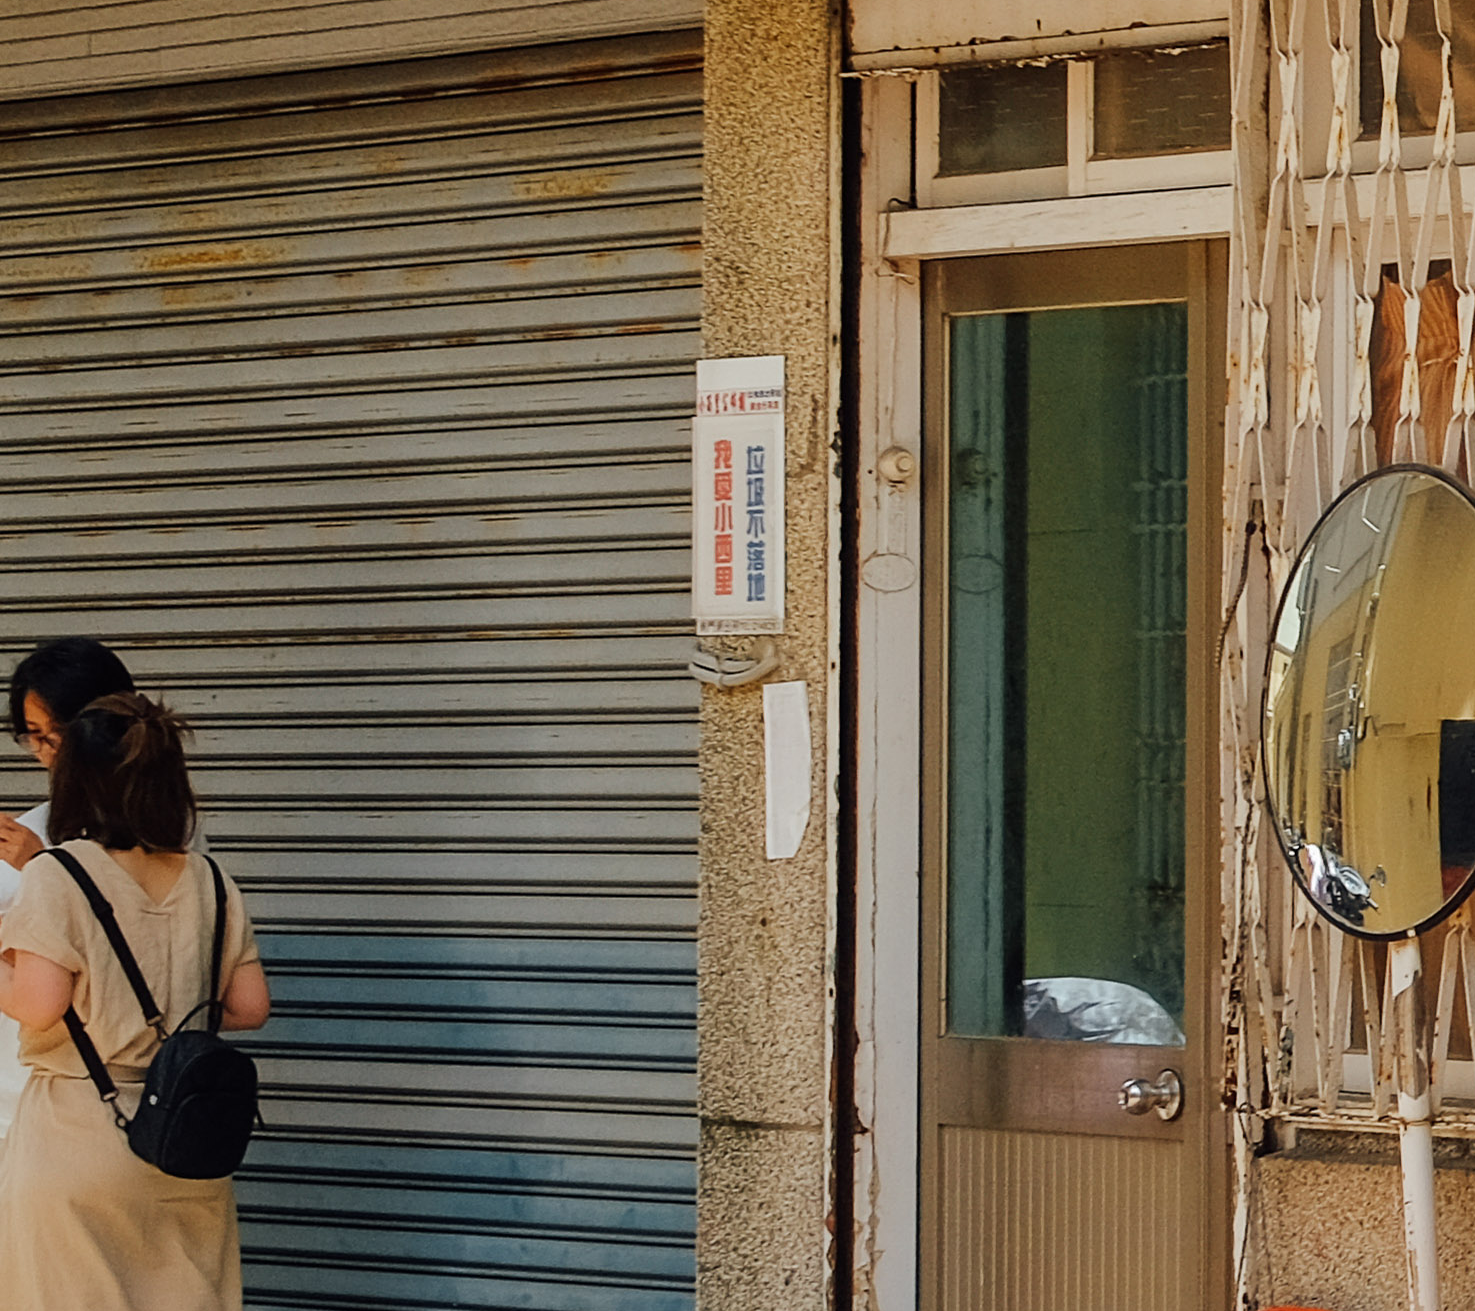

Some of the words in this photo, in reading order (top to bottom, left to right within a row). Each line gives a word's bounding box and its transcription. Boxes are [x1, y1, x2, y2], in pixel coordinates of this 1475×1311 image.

[714, 440, 733, 595] 我愛小西里
[746, 445, 766, 602] 垃圾不落地
